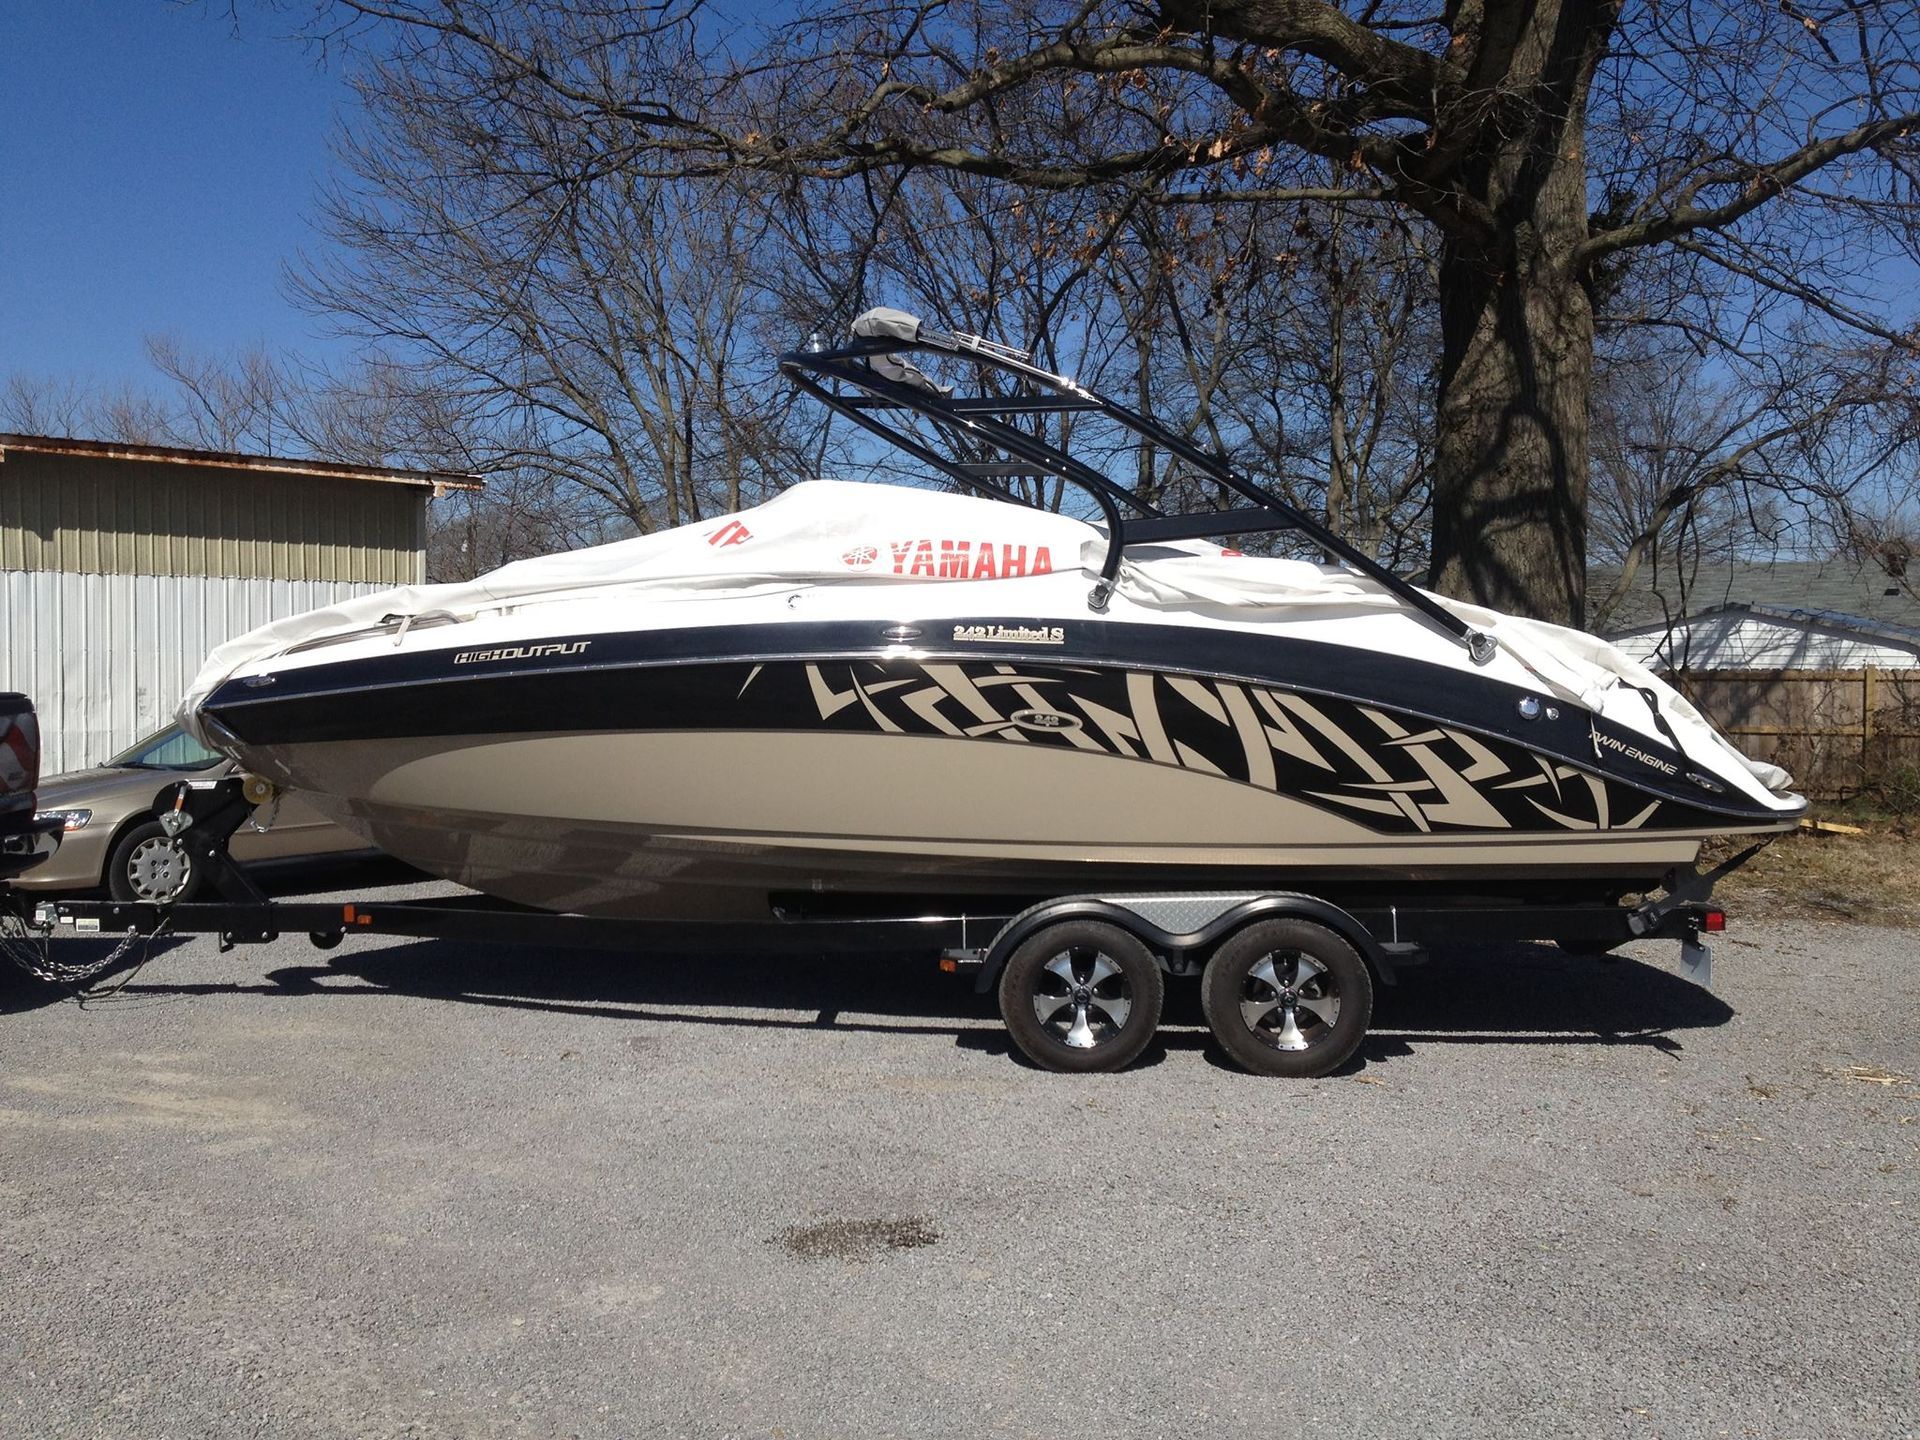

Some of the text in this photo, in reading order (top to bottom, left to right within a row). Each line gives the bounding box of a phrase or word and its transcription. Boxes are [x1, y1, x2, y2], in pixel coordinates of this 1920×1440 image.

[890, 539, 1053, 581] YAMAHA
[953, 625, 1064, 641] 242 Limited S
[1625, 746, 1678, 775] ENGINE
